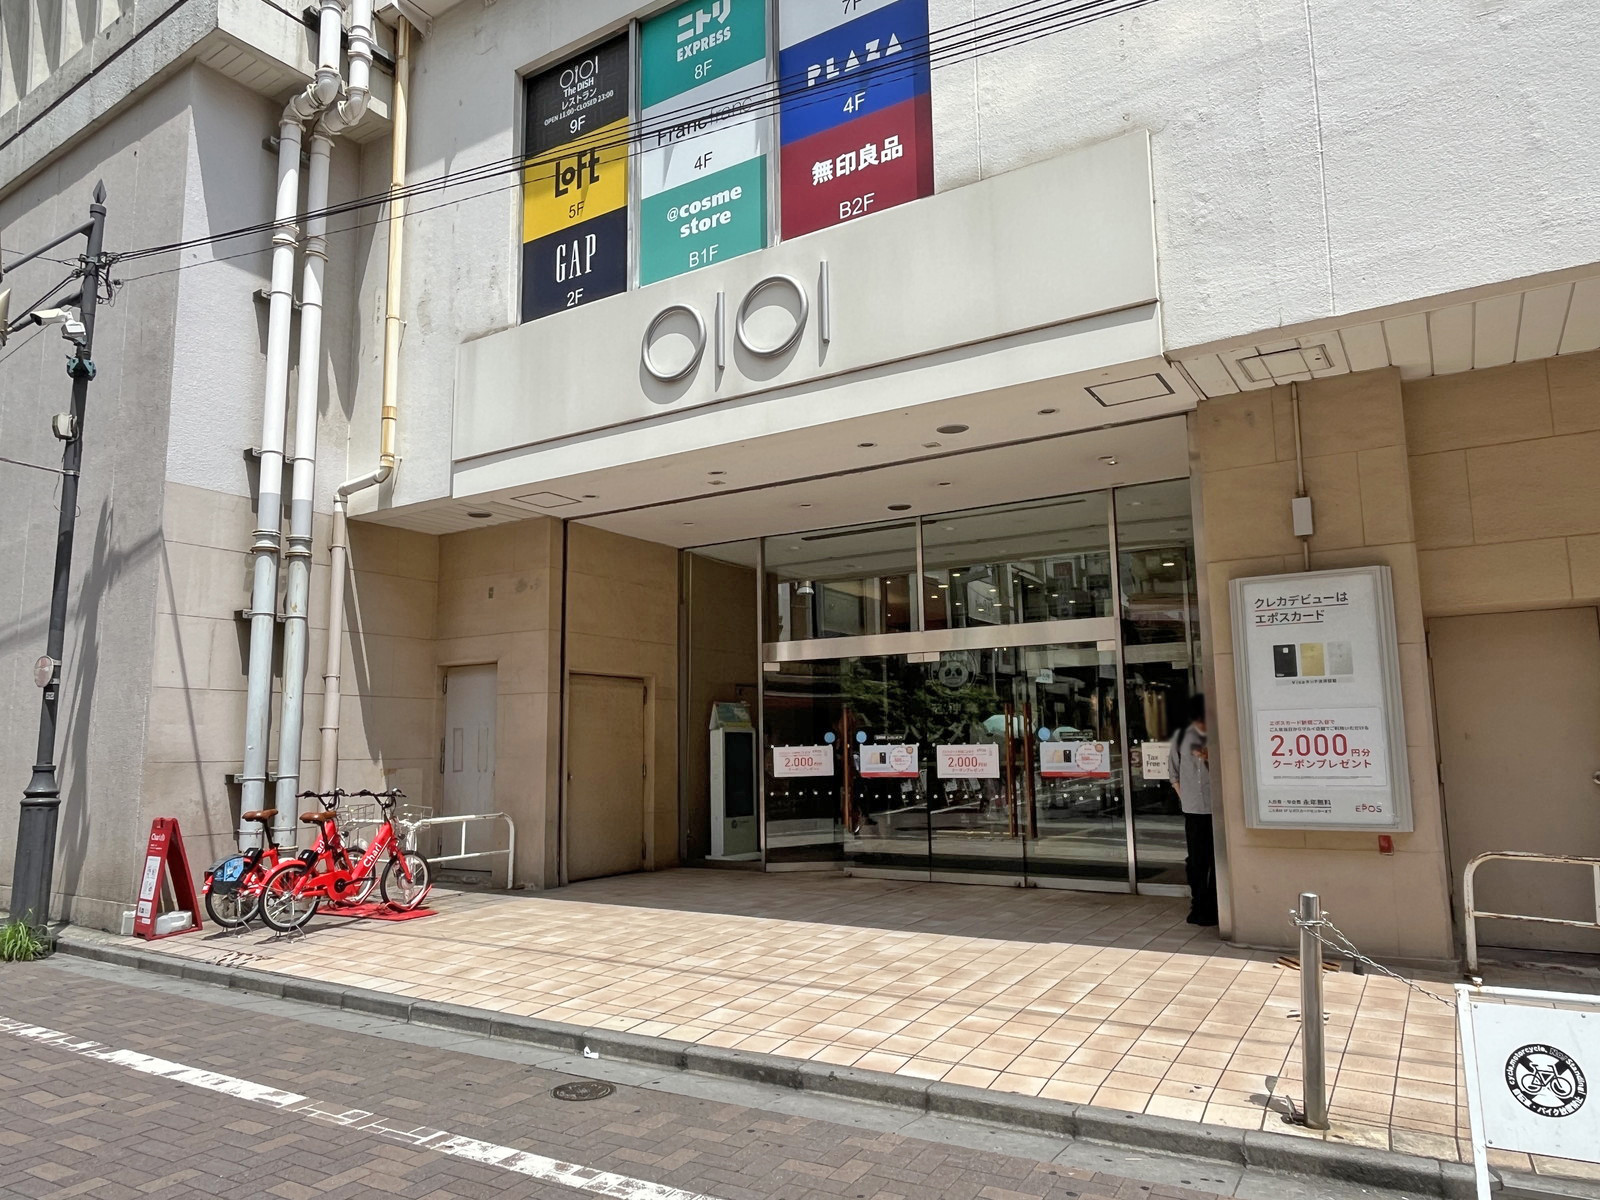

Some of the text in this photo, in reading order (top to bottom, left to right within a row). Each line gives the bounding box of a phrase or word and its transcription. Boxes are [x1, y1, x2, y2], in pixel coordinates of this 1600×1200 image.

[677, 0, 731, 43] ニトリ
[677, 26, 731, 62] EXPRESS
[694, 59, 713, 79] 8F
[807, 32, 903, 87] PLAZA
[563, 76, 594, 98] The DISH
[543, 114, 559, 126] OPEN
[597, 89, 614, 103] 23:00
[562, 88, 597, 111] レストラン
[842, 91, 866, 114] 4F
[569, 114, 586, 134] 9F
[693, 151, 713, 171] 4F
[811, 134, 903, 186] 無印良品
[568, 200, 585, 219] 5F
[666, 185, 743, 222] @cosme
[839, 192, 875, 220] B2F
[680, 209, 732, 238] store
[555, 233, 597, 283] GAP
[689, 244, 719, 268] B1F
[566, 287, 584, 307] 2F
[1254, 591, 1349, 609] クレカデビューは
[1255, 609, 1325, 624] エポスカード
[1147, 753, 1159, 761] Tax
[1272, 759, 1372, 769] クーポンプレゼント
[1355, 803, 1383, 813] EPOS
